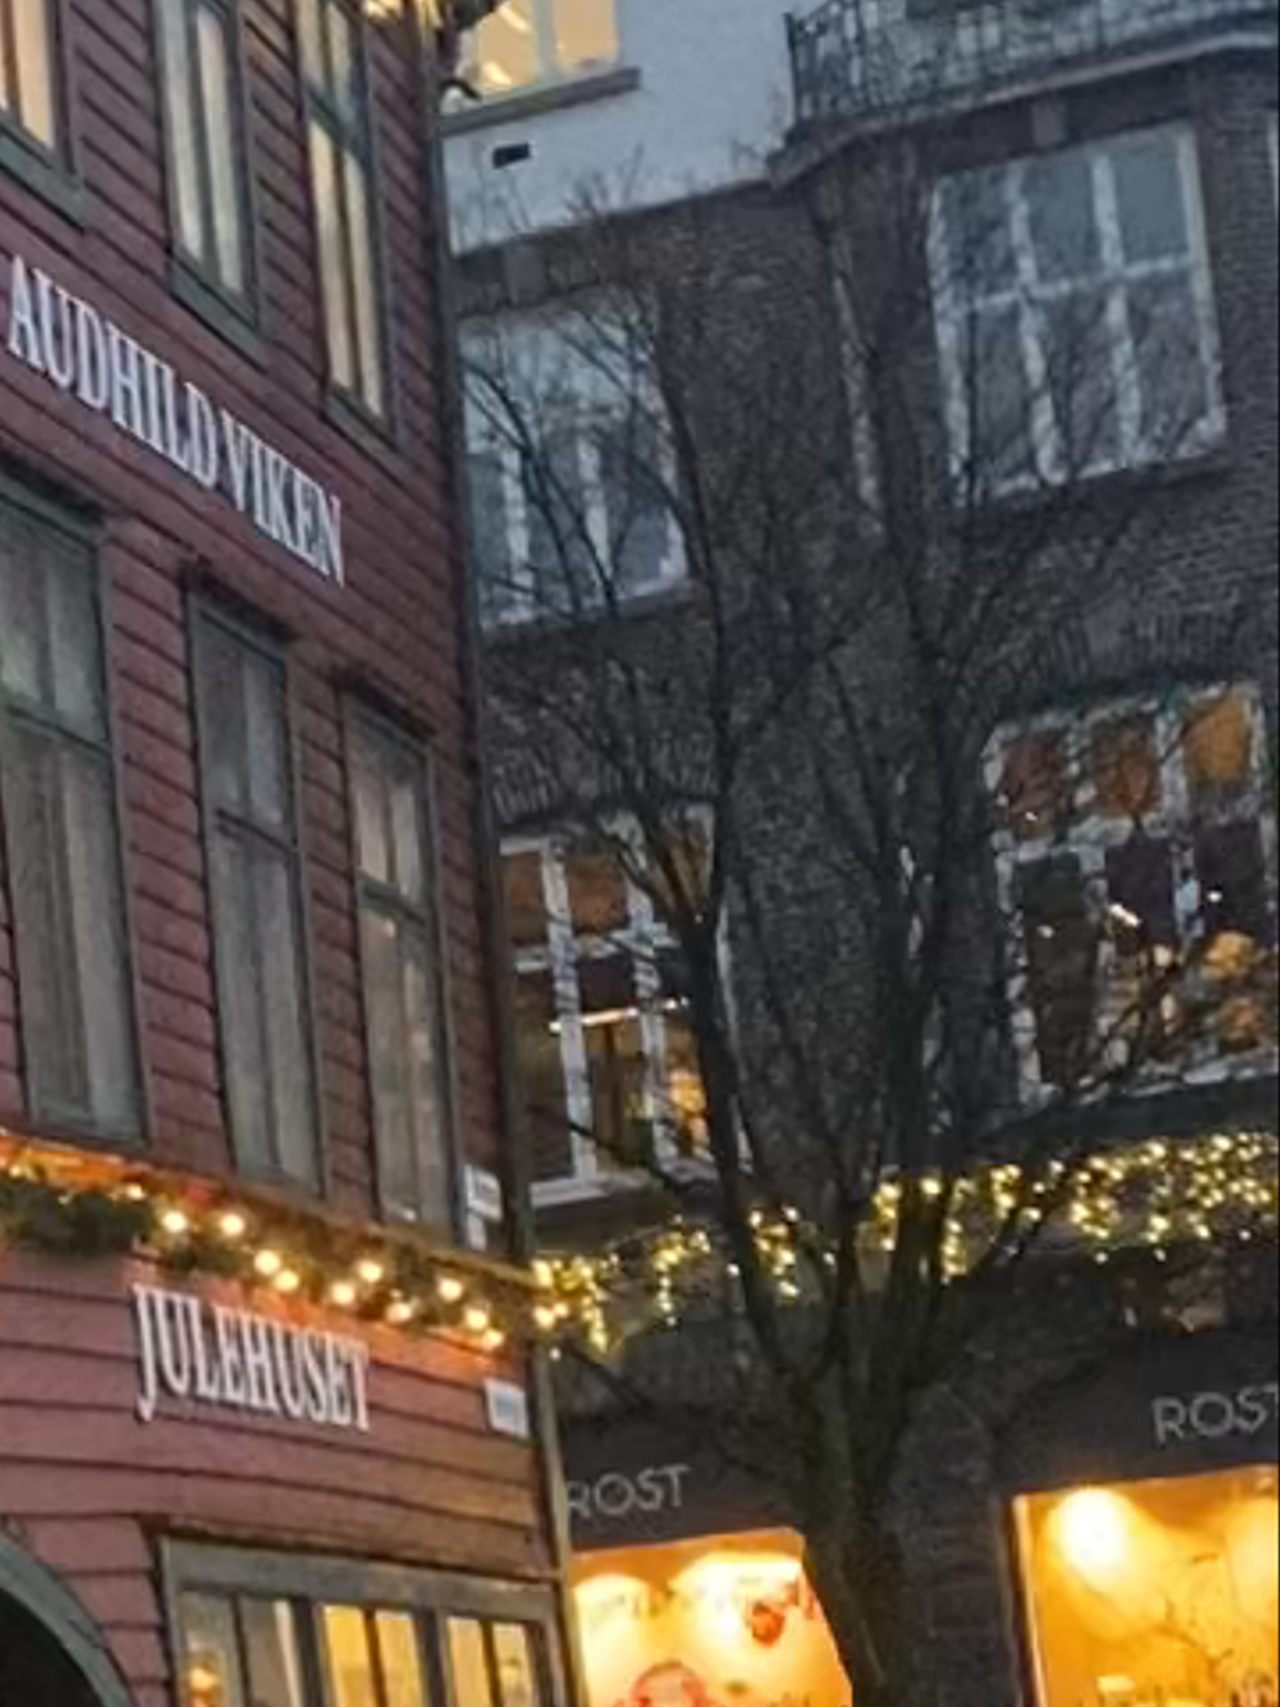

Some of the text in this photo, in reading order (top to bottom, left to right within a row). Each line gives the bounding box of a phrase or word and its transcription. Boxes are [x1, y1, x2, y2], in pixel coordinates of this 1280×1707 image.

[7, 254, 345, 588] AUDHILD VIKEN
[133, 1284, 370, 1432] JULEHUSET
